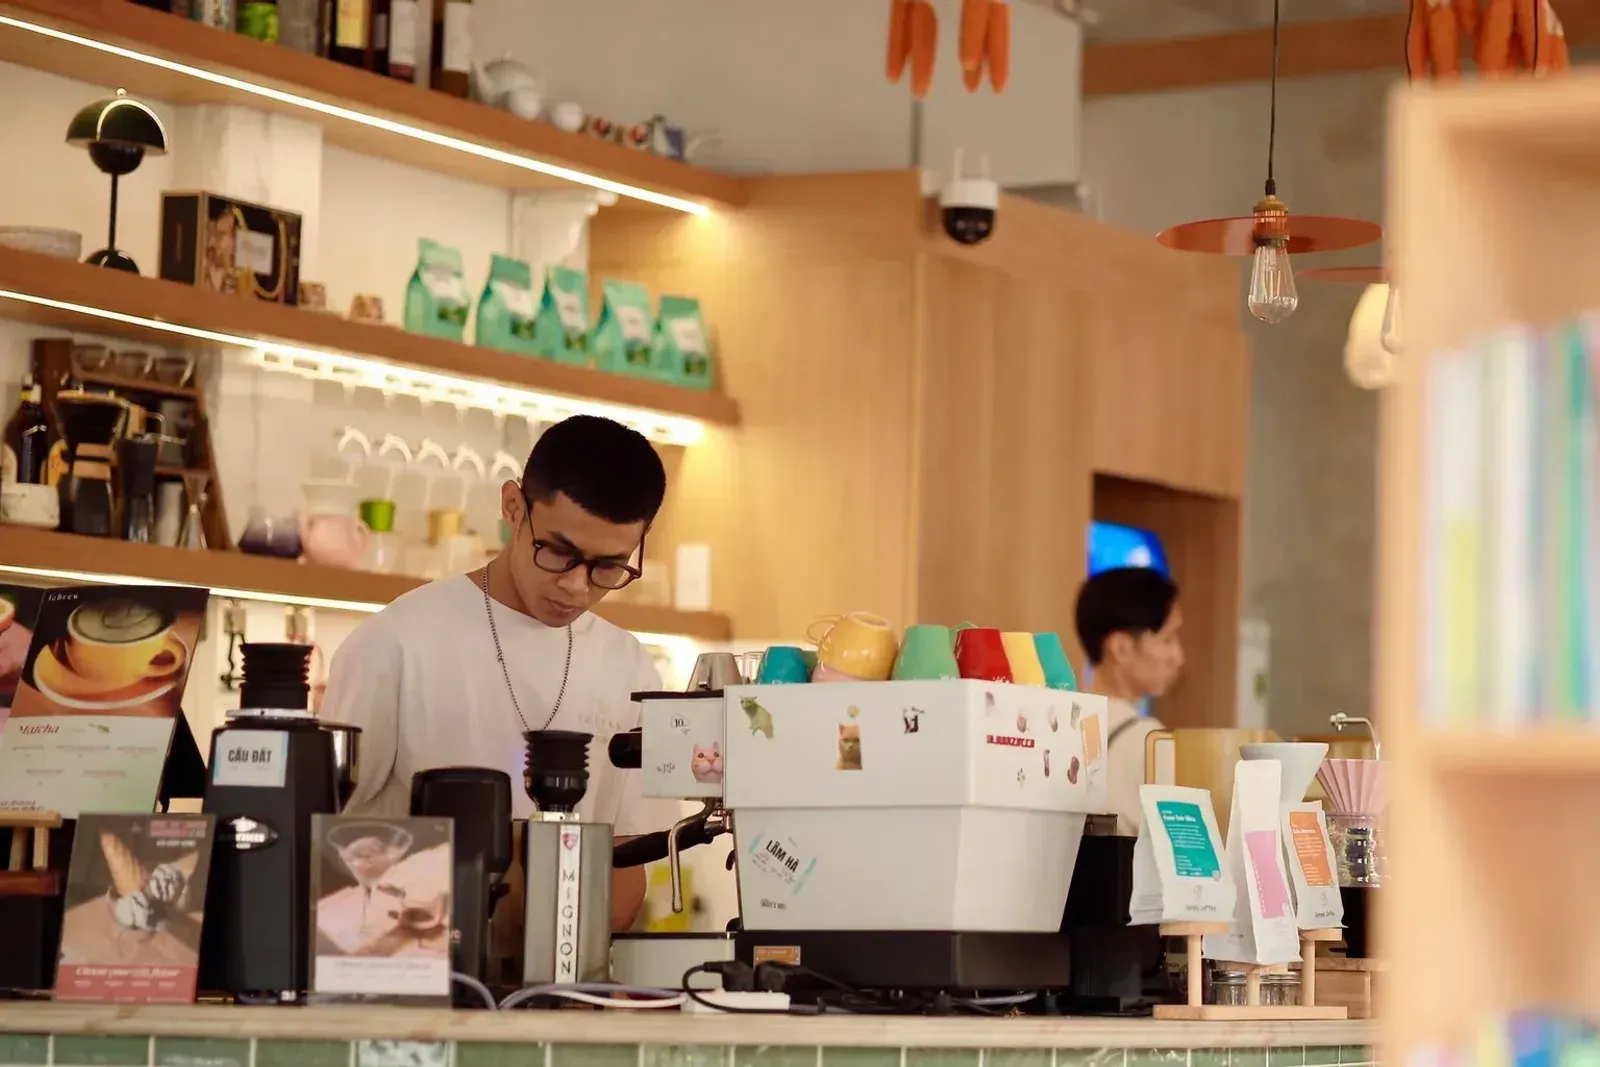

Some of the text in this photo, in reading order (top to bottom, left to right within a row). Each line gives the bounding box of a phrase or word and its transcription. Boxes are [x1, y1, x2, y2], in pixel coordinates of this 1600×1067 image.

[19, 724, 60, 735] Matcha
[784, 856, 799, 873] HÀ
[560, 869, 575, 975] MIGNON
